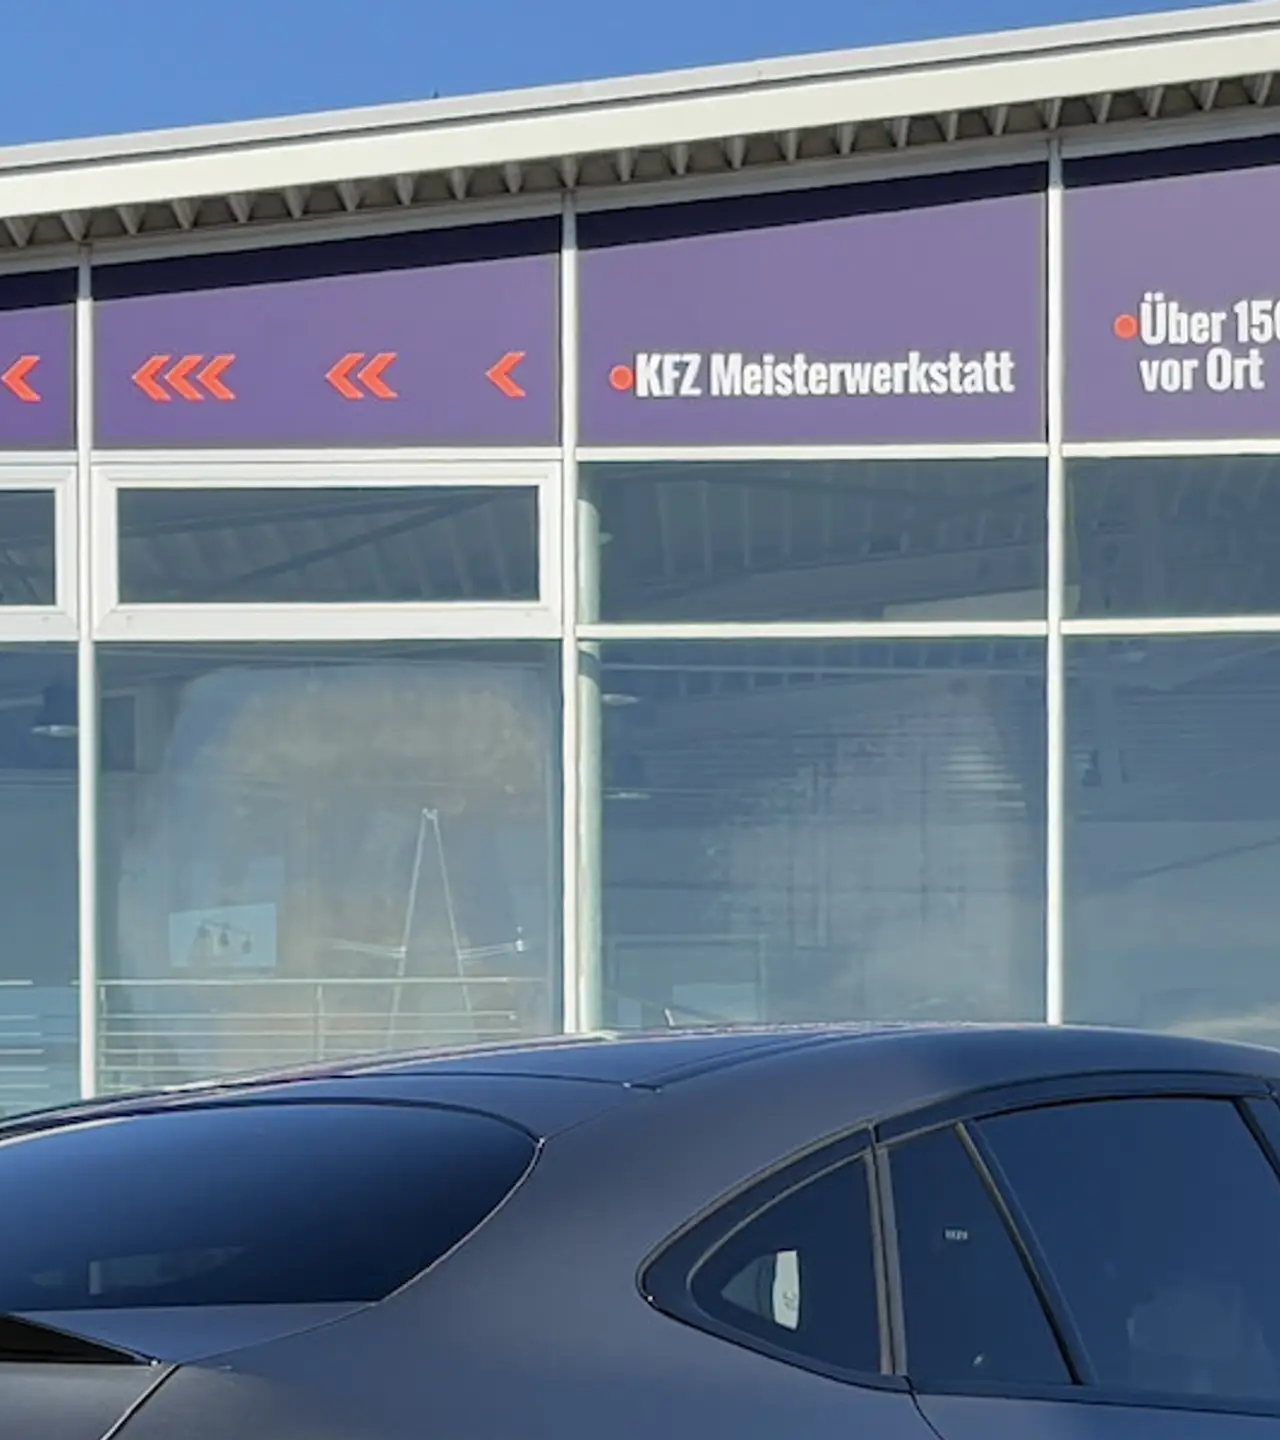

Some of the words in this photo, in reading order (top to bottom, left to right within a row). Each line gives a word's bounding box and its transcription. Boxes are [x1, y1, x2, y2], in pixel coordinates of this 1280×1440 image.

[1140, 291, 1227, 345] Über
[636, 353, 702, 396] KFZ
[710, 351, 1015, 395] Meisterwerkstatt
[1140, 358, 1198, 391] vor
[1206, 347, 1265, 390] Ort
